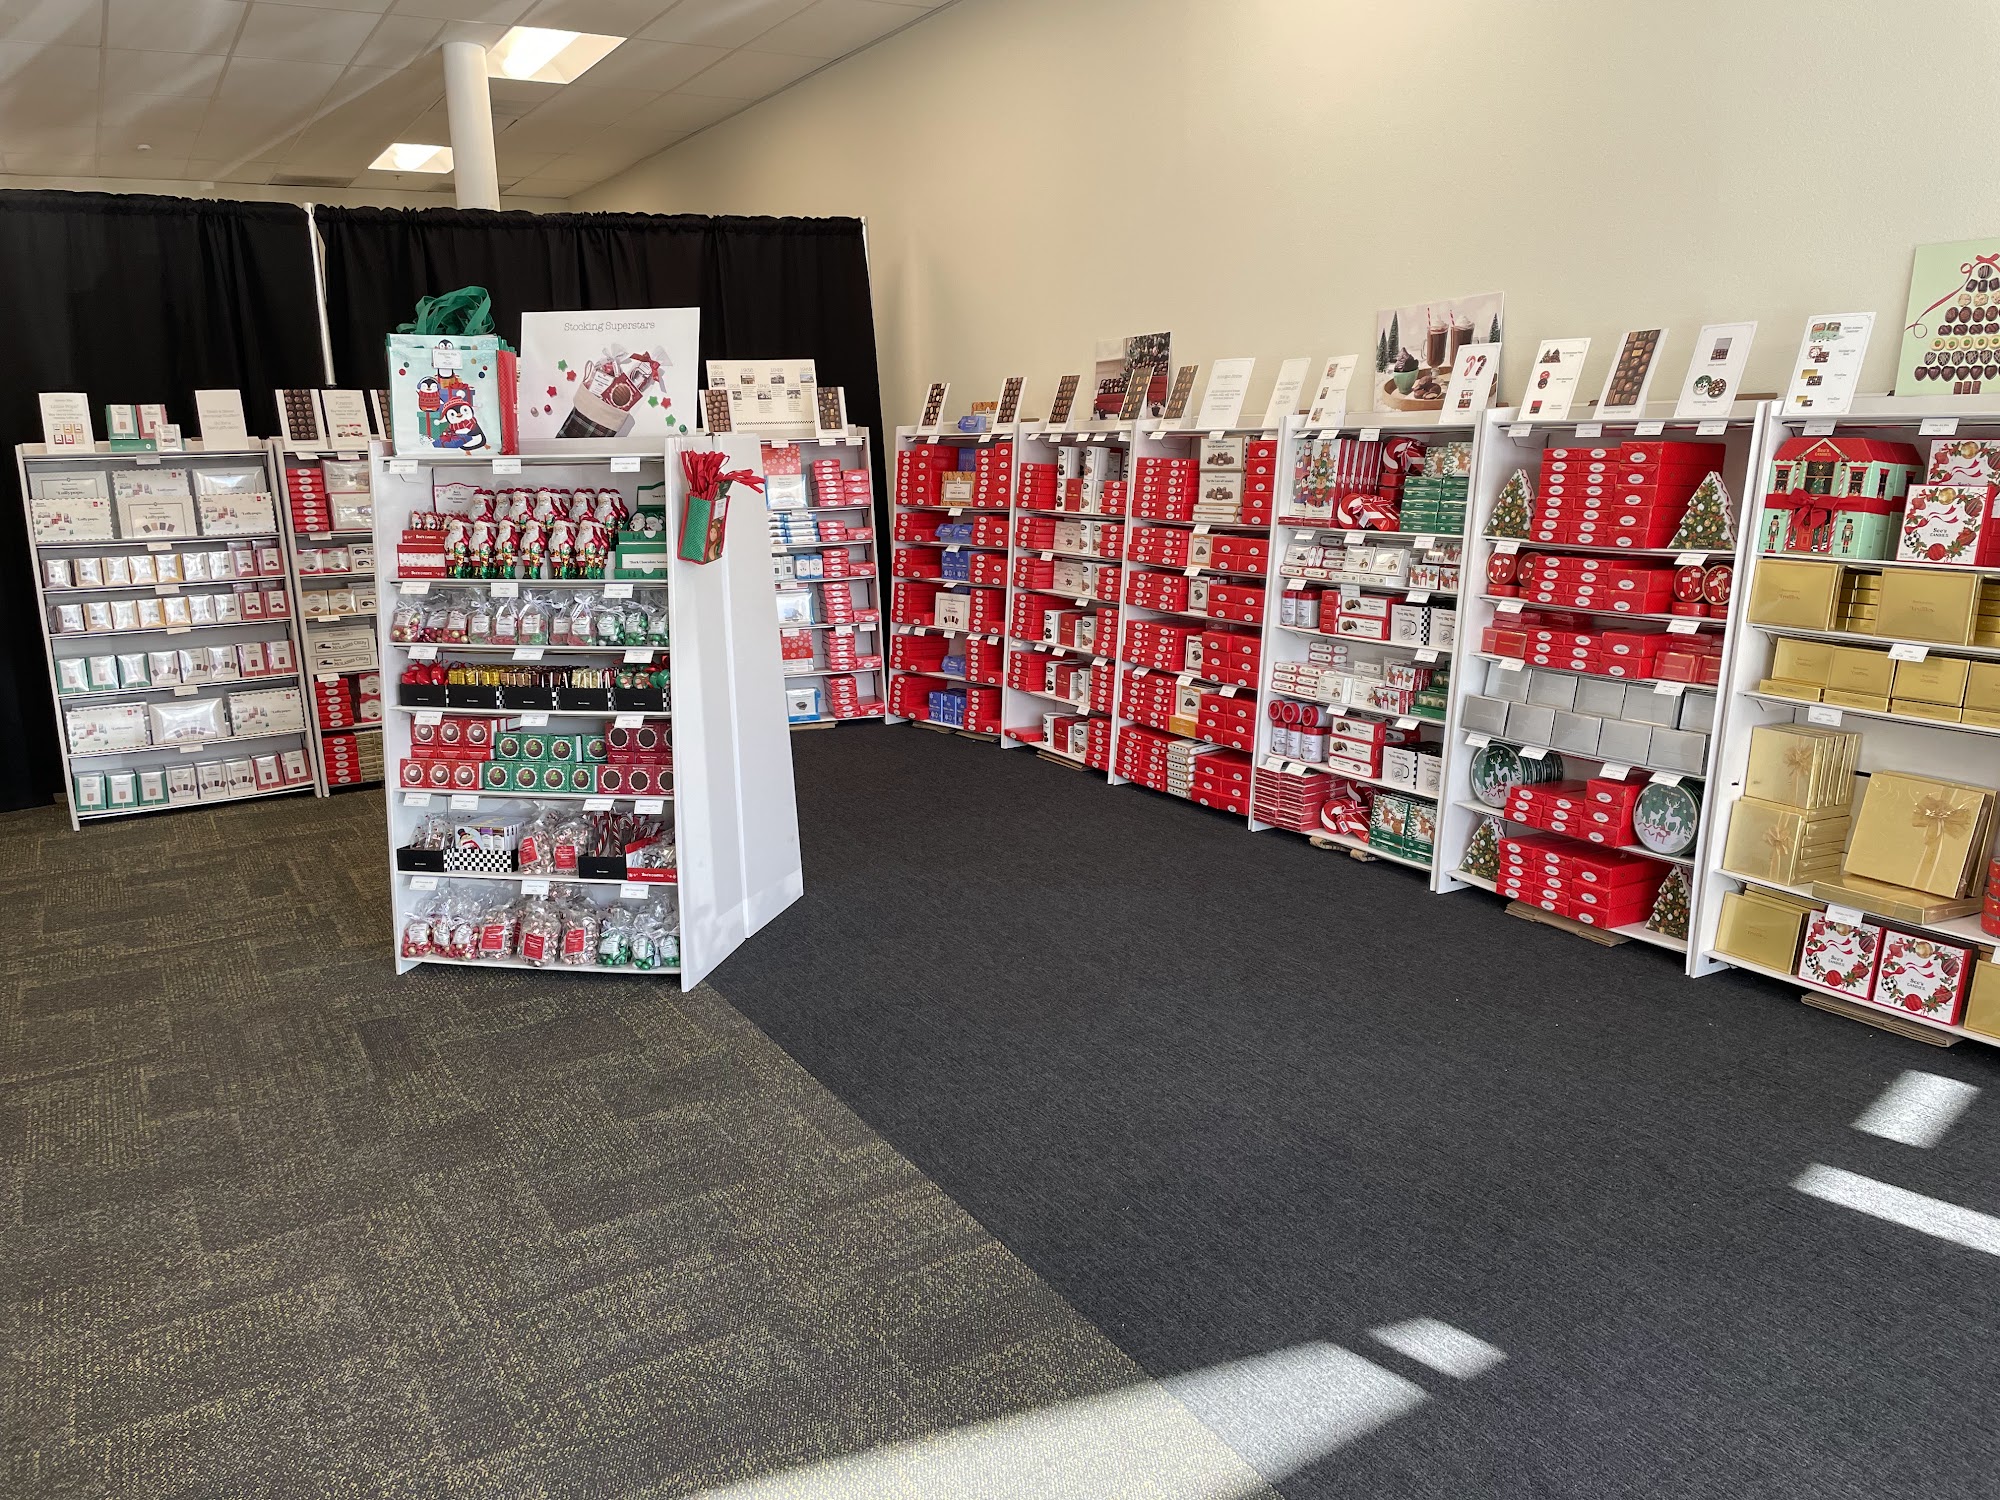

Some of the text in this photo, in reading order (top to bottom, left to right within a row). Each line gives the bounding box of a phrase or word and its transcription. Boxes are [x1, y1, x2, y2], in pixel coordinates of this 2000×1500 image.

[564, 321, 655, 332] Stocking Superstars
[1828, 959, 1845, 967] CANDIES
[1830, 955, 1844, 963] See's
[1910, 978, 1924, 986] See's
[1907, 983, 1926, 991] CANDIES
